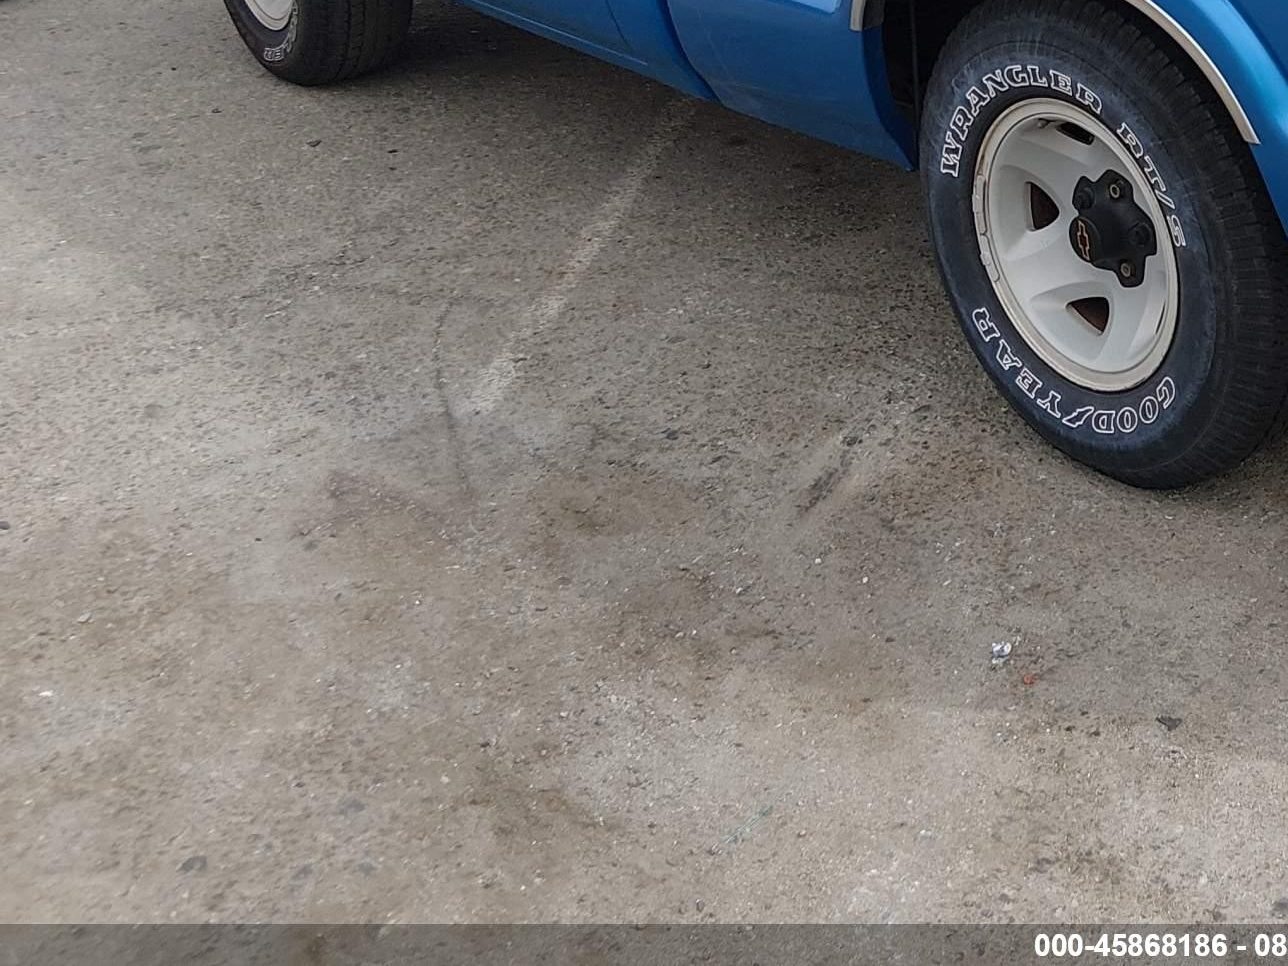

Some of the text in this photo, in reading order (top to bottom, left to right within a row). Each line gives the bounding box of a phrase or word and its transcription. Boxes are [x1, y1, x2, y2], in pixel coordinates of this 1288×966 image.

[940, 64, 1186, 248] WRANGLER RT/S
[972, 306, 1176, 434] GOODYEAR
